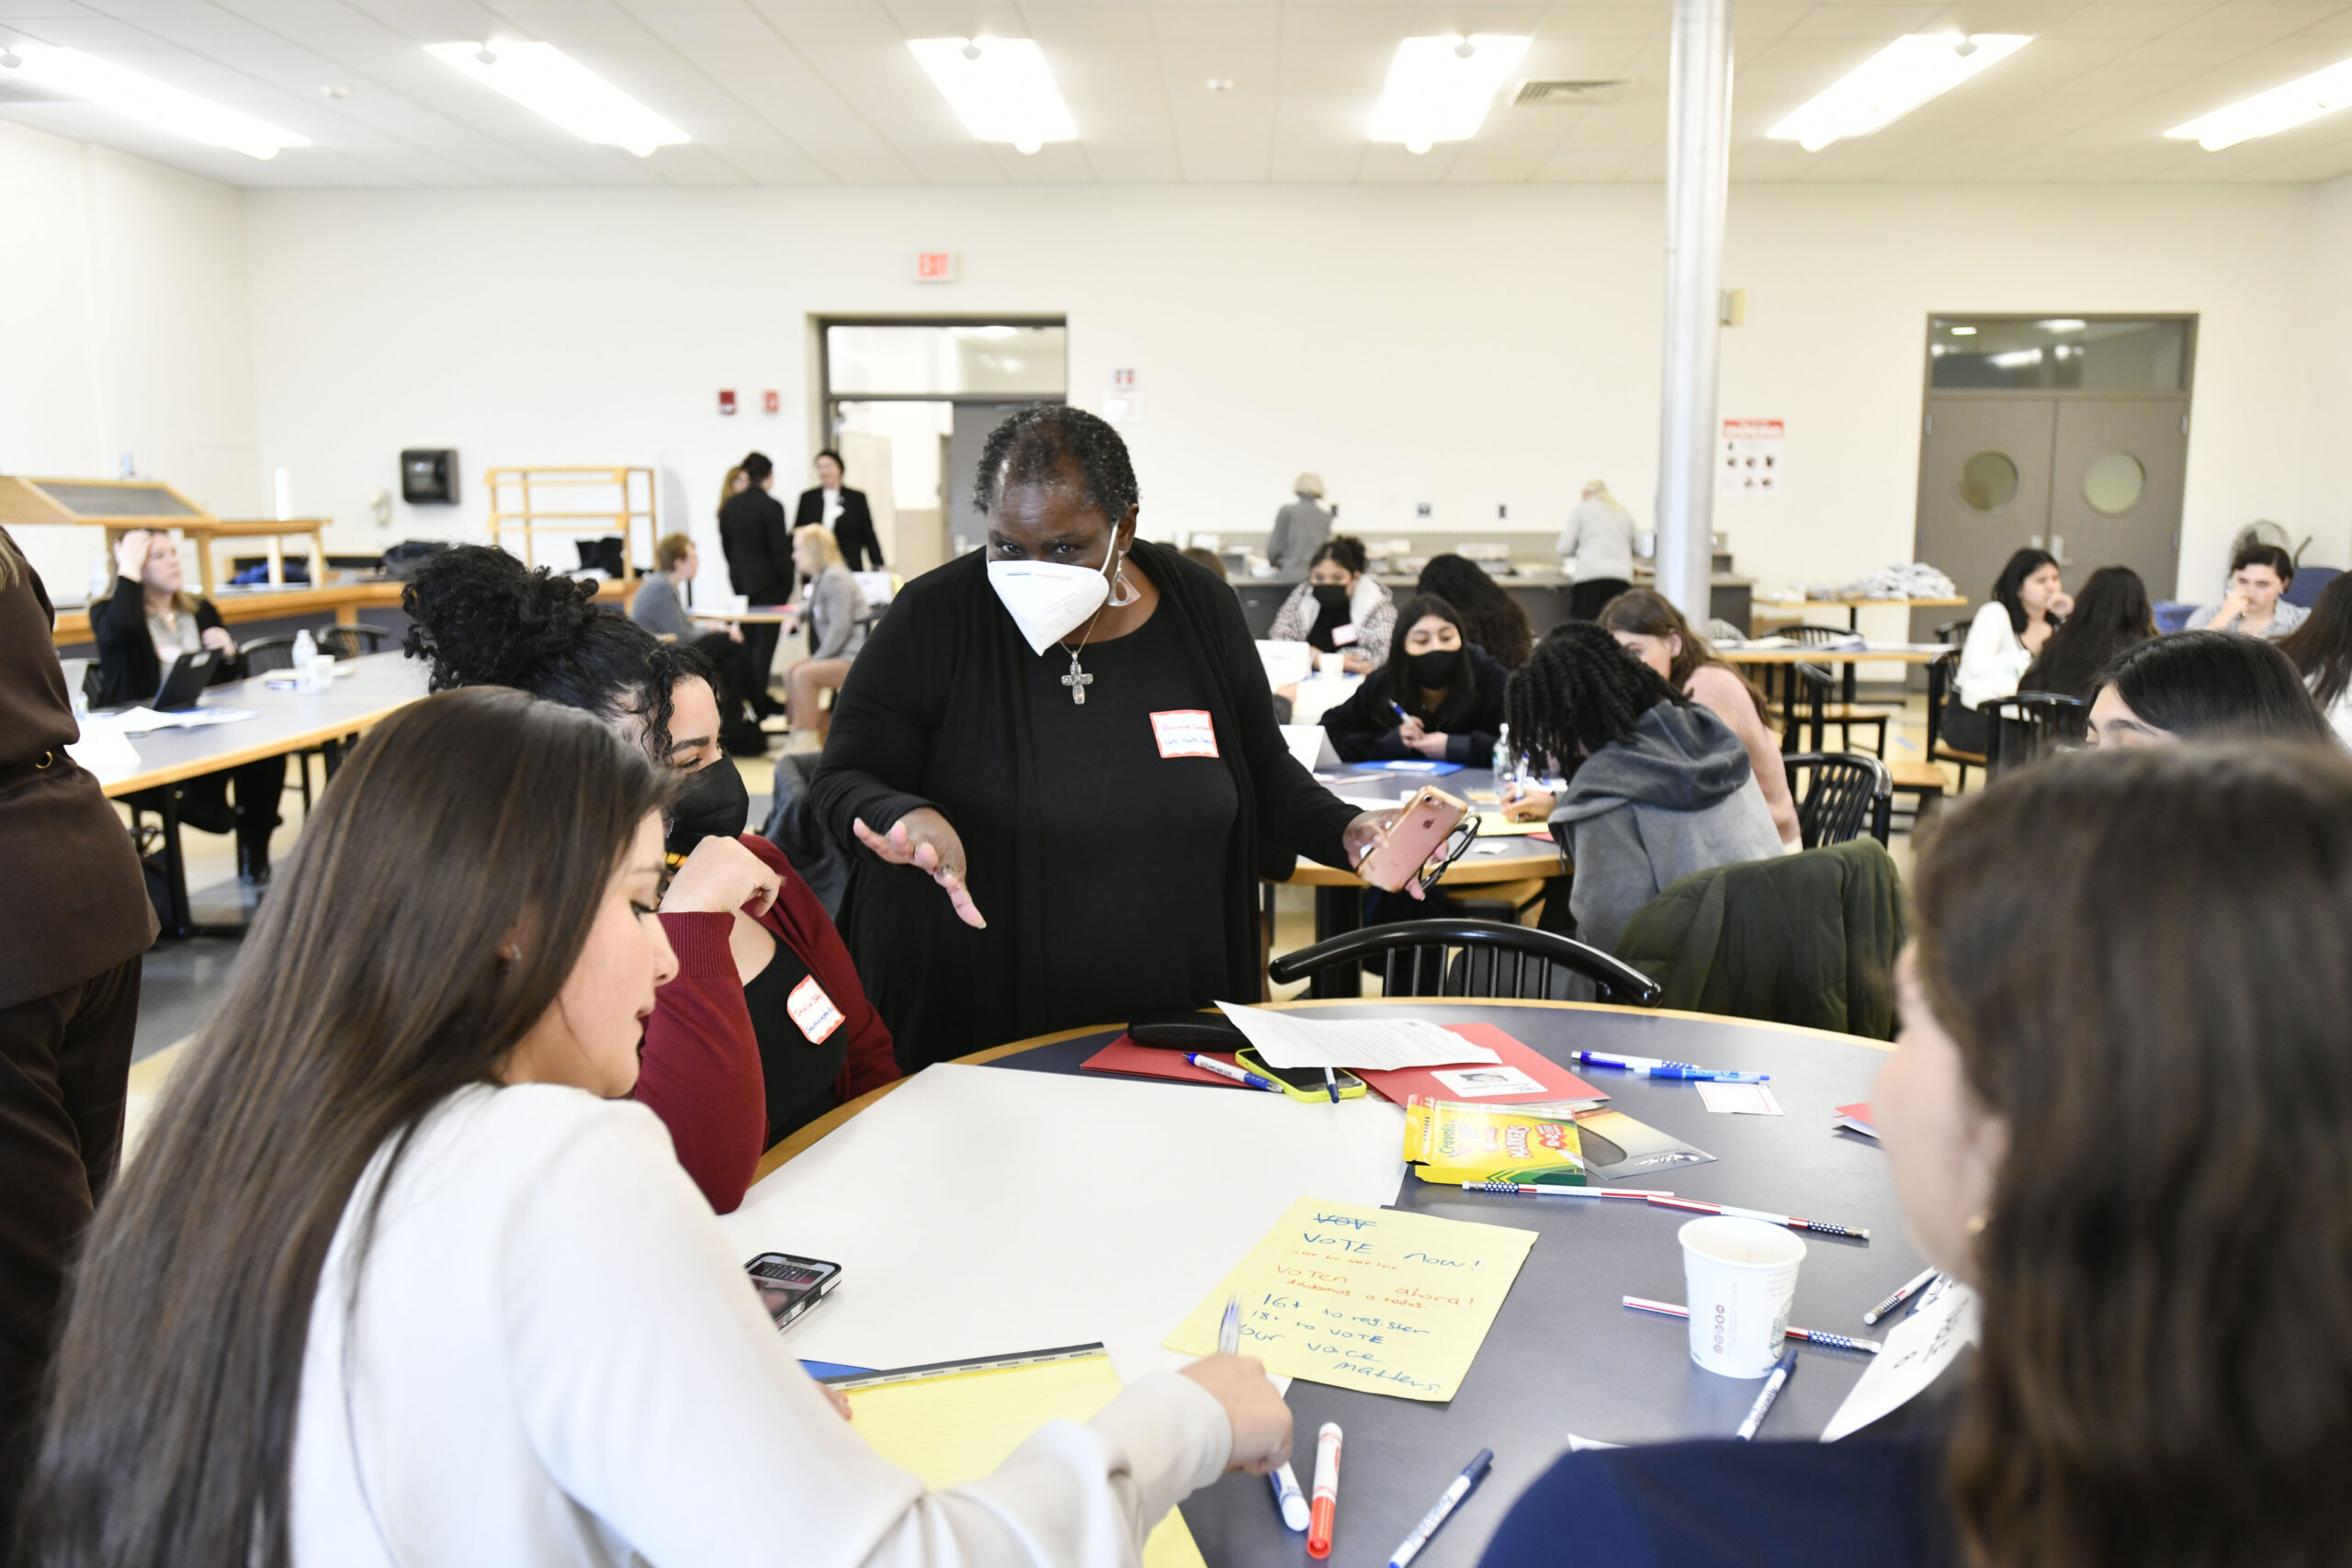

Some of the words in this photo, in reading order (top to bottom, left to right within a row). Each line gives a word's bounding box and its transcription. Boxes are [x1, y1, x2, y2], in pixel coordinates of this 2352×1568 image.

[919, 253, 948, 277] EXIT
[1506, 1124, 1532, 1158] MARKERS
[1262, 1293, 1300, 1308] 16+
[1323, 1308, 1343, 1318] to
[1296, 1321, 1315, 1330] to
